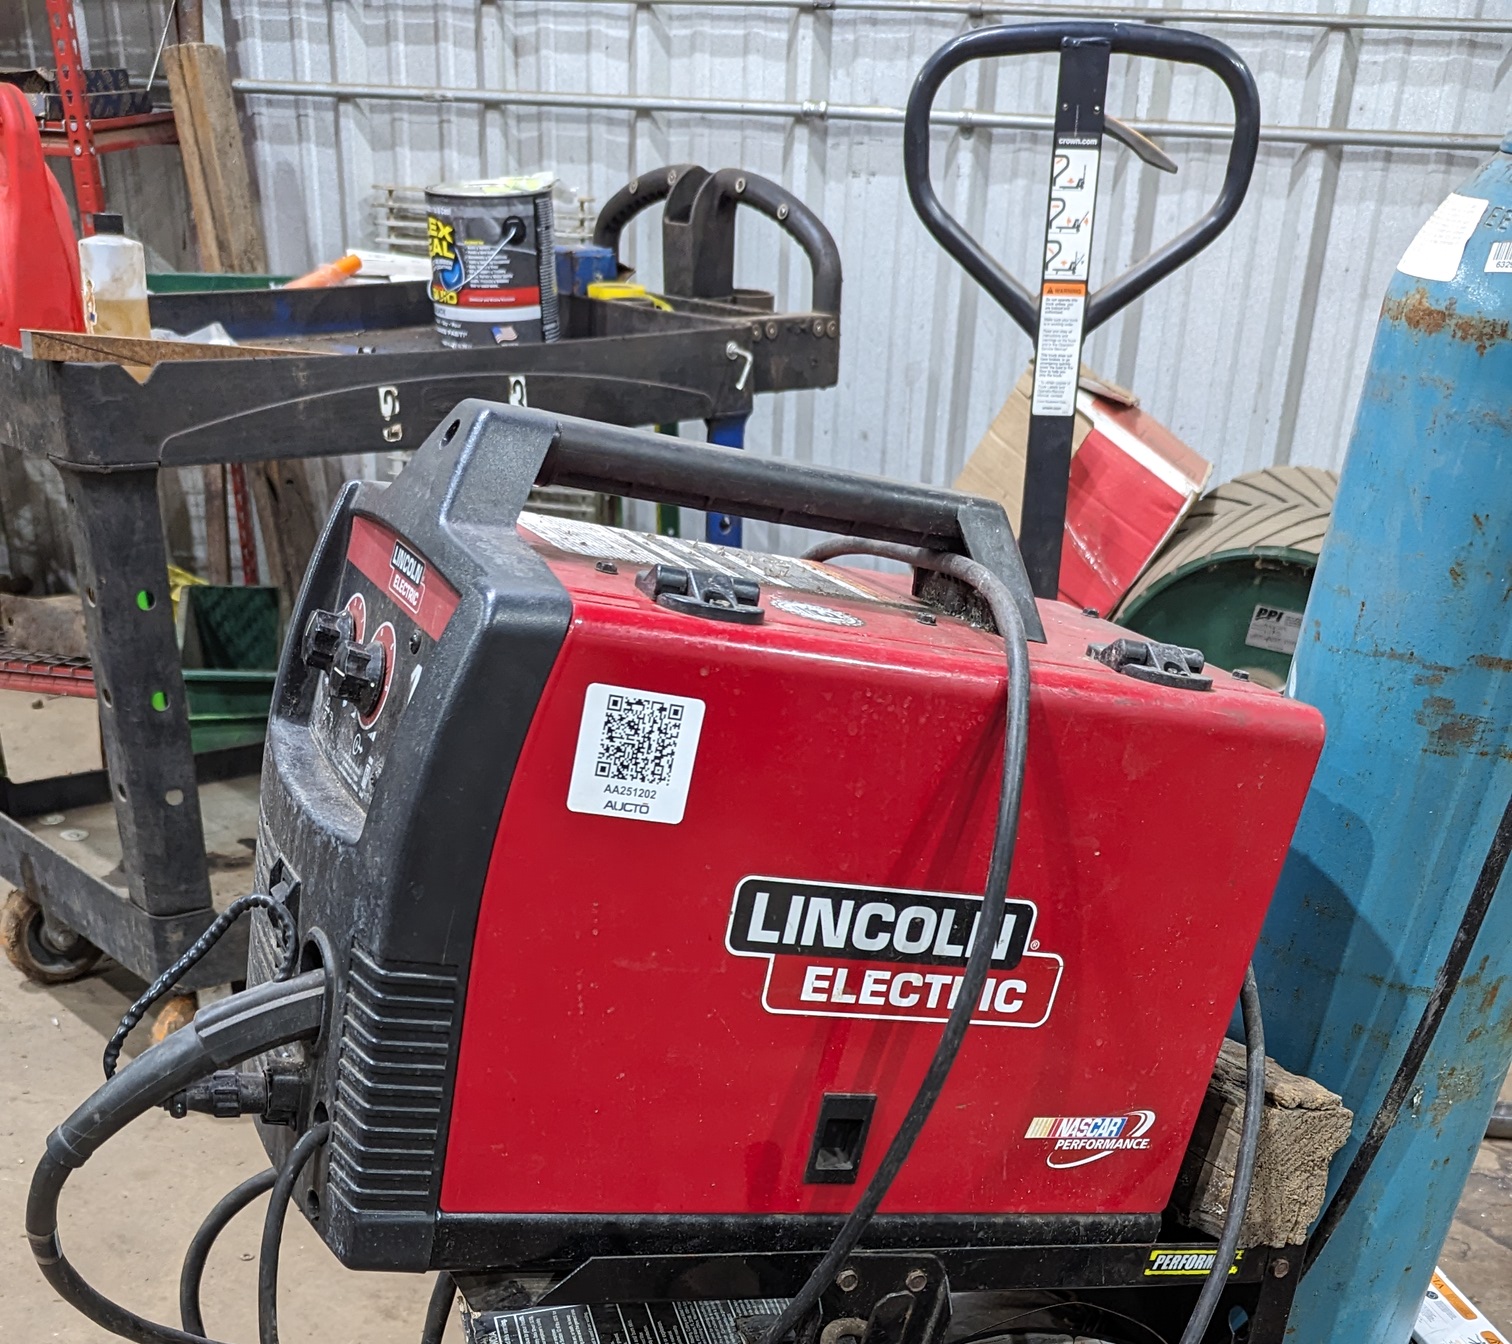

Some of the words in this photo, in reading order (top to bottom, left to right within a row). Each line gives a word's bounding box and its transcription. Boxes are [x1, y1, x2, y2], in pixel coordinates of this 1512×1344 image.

[1058, 138, 1098, 146] crown.com
[428, 217, 453, 243] EX
[391, 544, 424, 584] LINCOLN
[392, 574, 419, 606] ELECTRIC
[1255, 607, 1284, 622] PPI
[603, 784, 657, 800] AA251202
[747, 891, 1016, 960] LINCOLN
[1055, 1116, 1121, 1138] NASCAR
